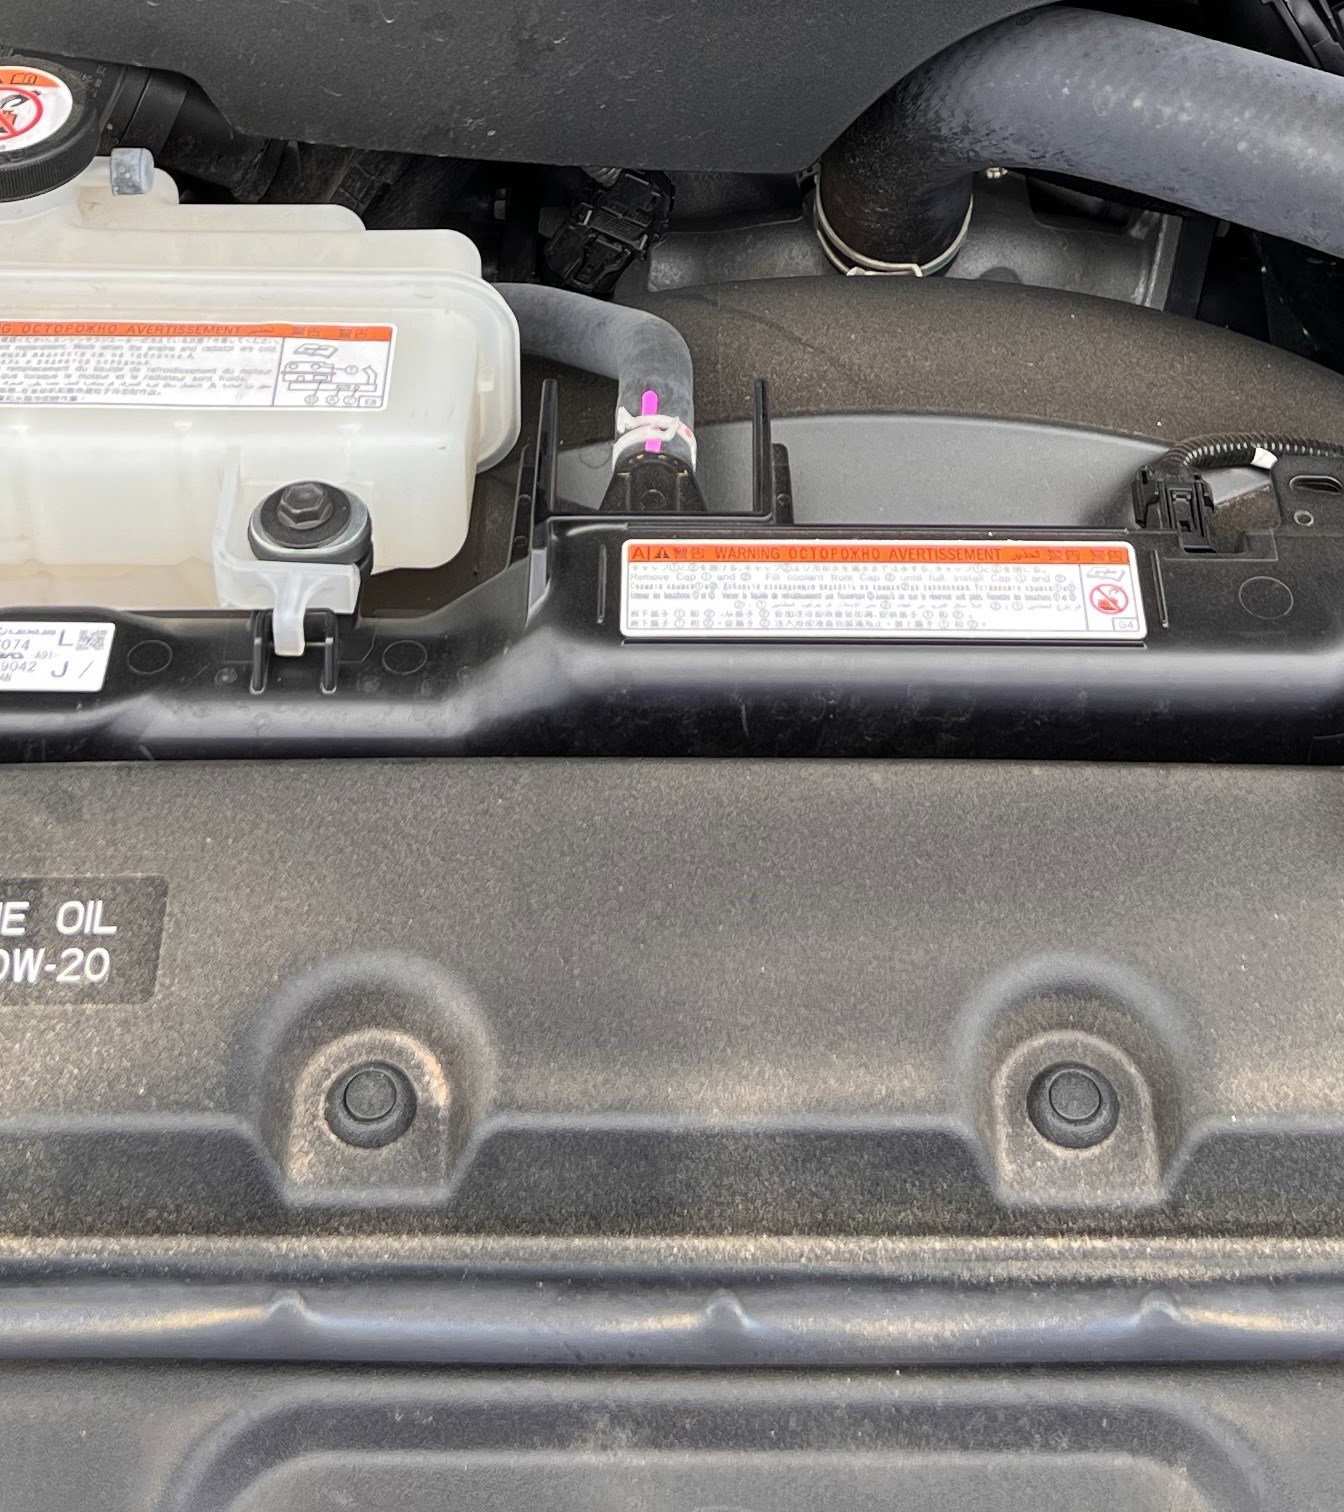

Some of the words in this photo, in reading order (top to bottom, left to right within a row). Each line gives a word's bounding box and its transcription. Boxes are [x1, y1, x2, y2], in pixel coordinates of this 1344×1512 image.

[127, 324, 242, 336] AVERTISSEMENT
[716, 546, 781, 560] WARNING
[889, 547, 1002, 562] AVERTISSEMENT
[55, 899, 118, 937] OIL
